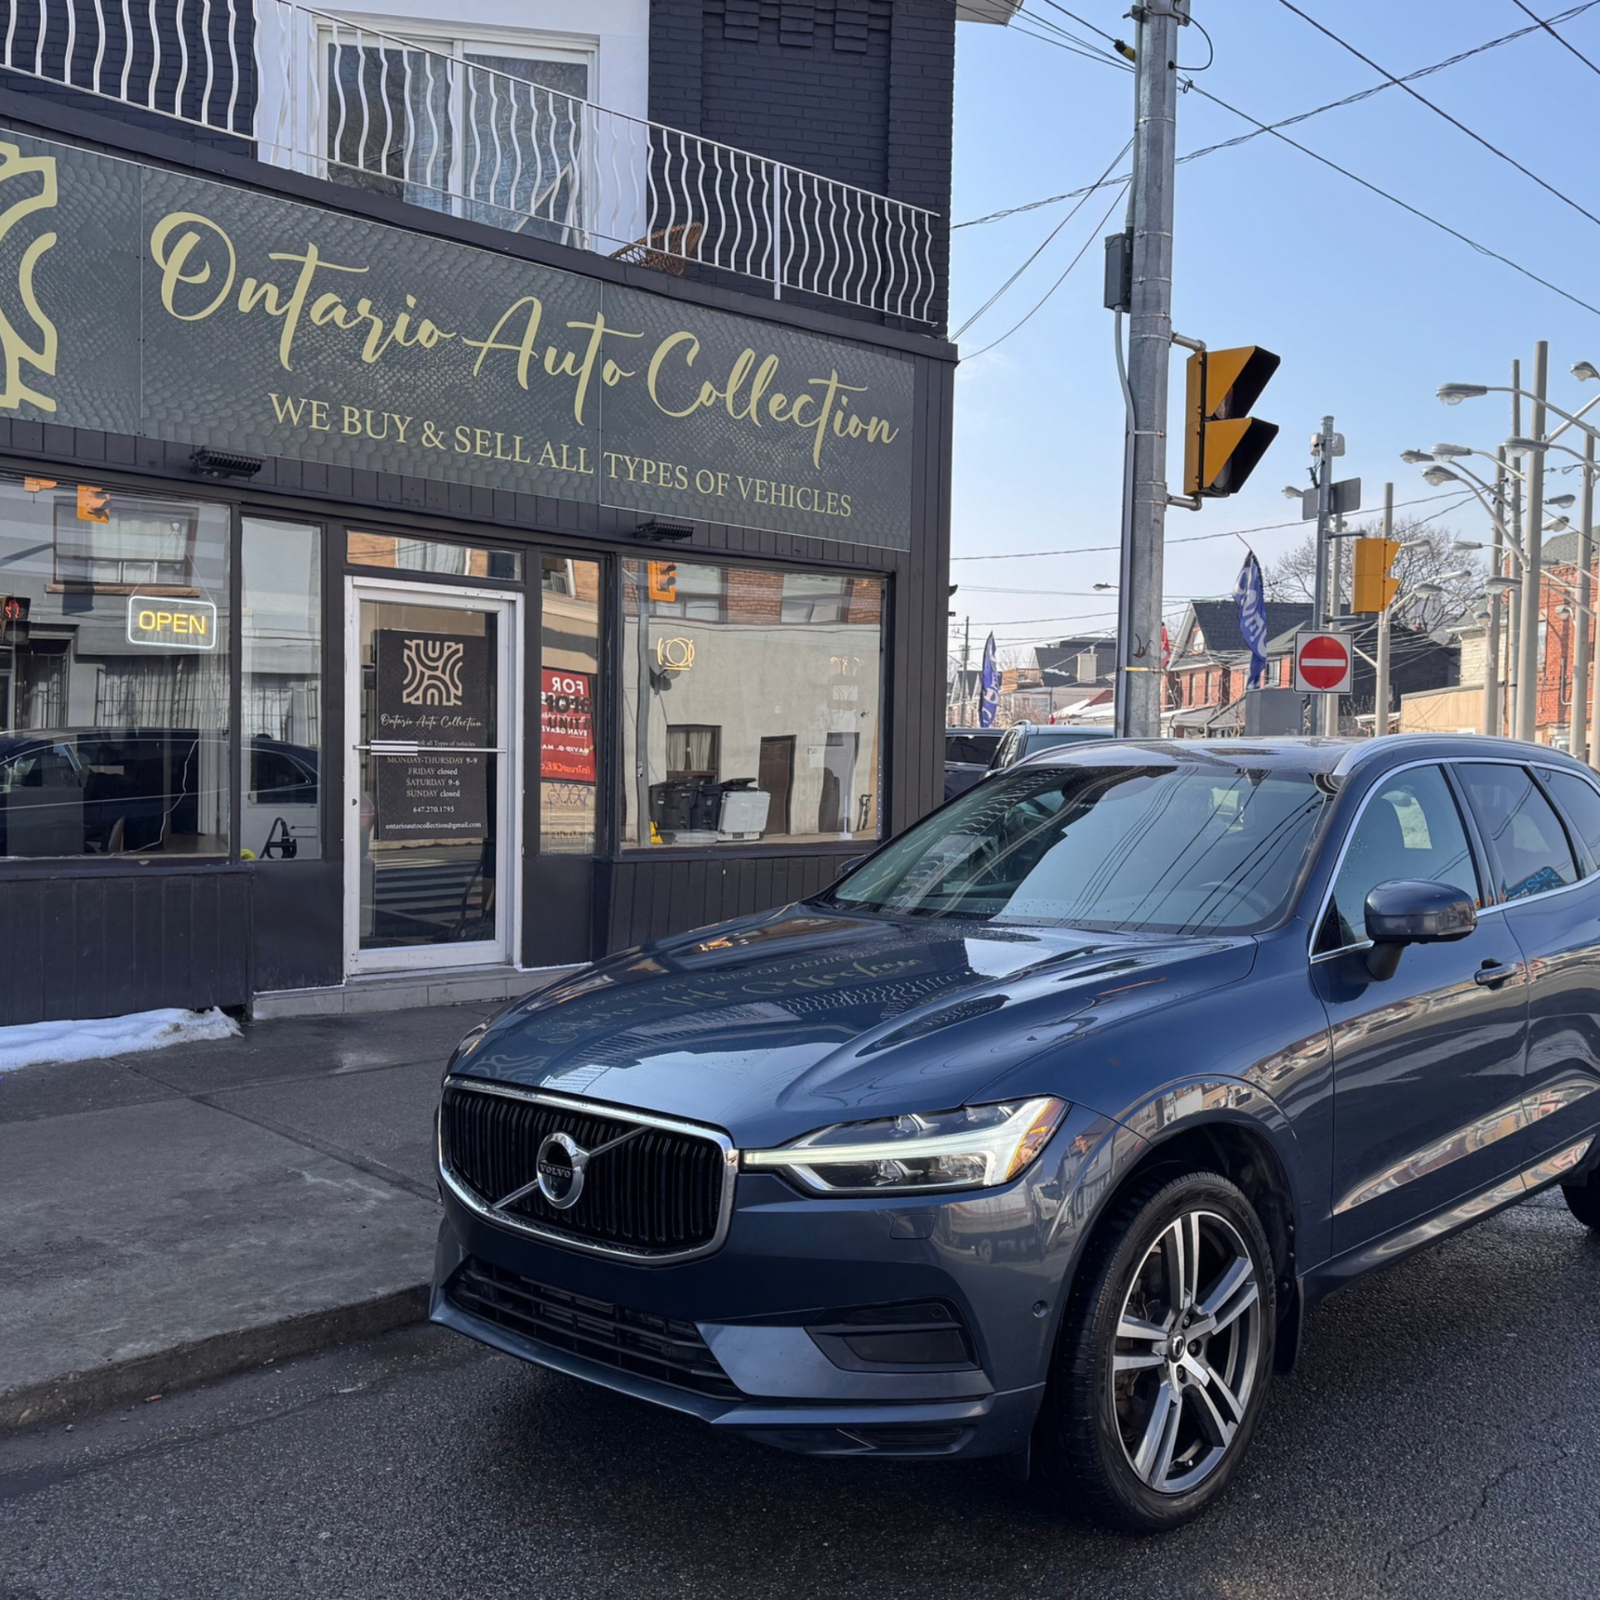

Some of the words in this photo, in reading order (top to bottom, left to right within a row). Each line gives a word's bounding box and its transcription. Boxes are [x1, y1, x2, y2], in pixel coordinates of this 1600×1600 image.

[150, 211, 457, 372] Ontario
[461, 295, 645, 427] Auto
[647, 331, 900, 471] Collection
[268, 393, 331, 431] WE
[341, 405, 414, 443] BUY
[421, 420, 447, 450] &
[454, 426, 531, 464] SELL
[537, 441, 595, 475] ALL
[603, 452, 689, 490] TYPES
[695, 469, 730, 497] OF
[736, 476, 852, 517] VEHICLES
[139, 610, 206, 635] OPEN
[381, 713, 413, 729] Ontario
[416, 714, 440, 731] Auto
[441, 715, 483, 731] Collection
[386, 756, 464, 764] MONDAY-THURSDAY
[408, 767, 436, 775] FRIDAY
[437, 767, 458, 775] closed
[406, 778, 446, 786] SATURDAY
[406, 789, 438, 797] SUNDAY
[440, 789, 461, 797] closed
[385, 821, 482, 830] ontarioautocollection@gmail.com
[539, 1164, 571, 1178] VOLVO
